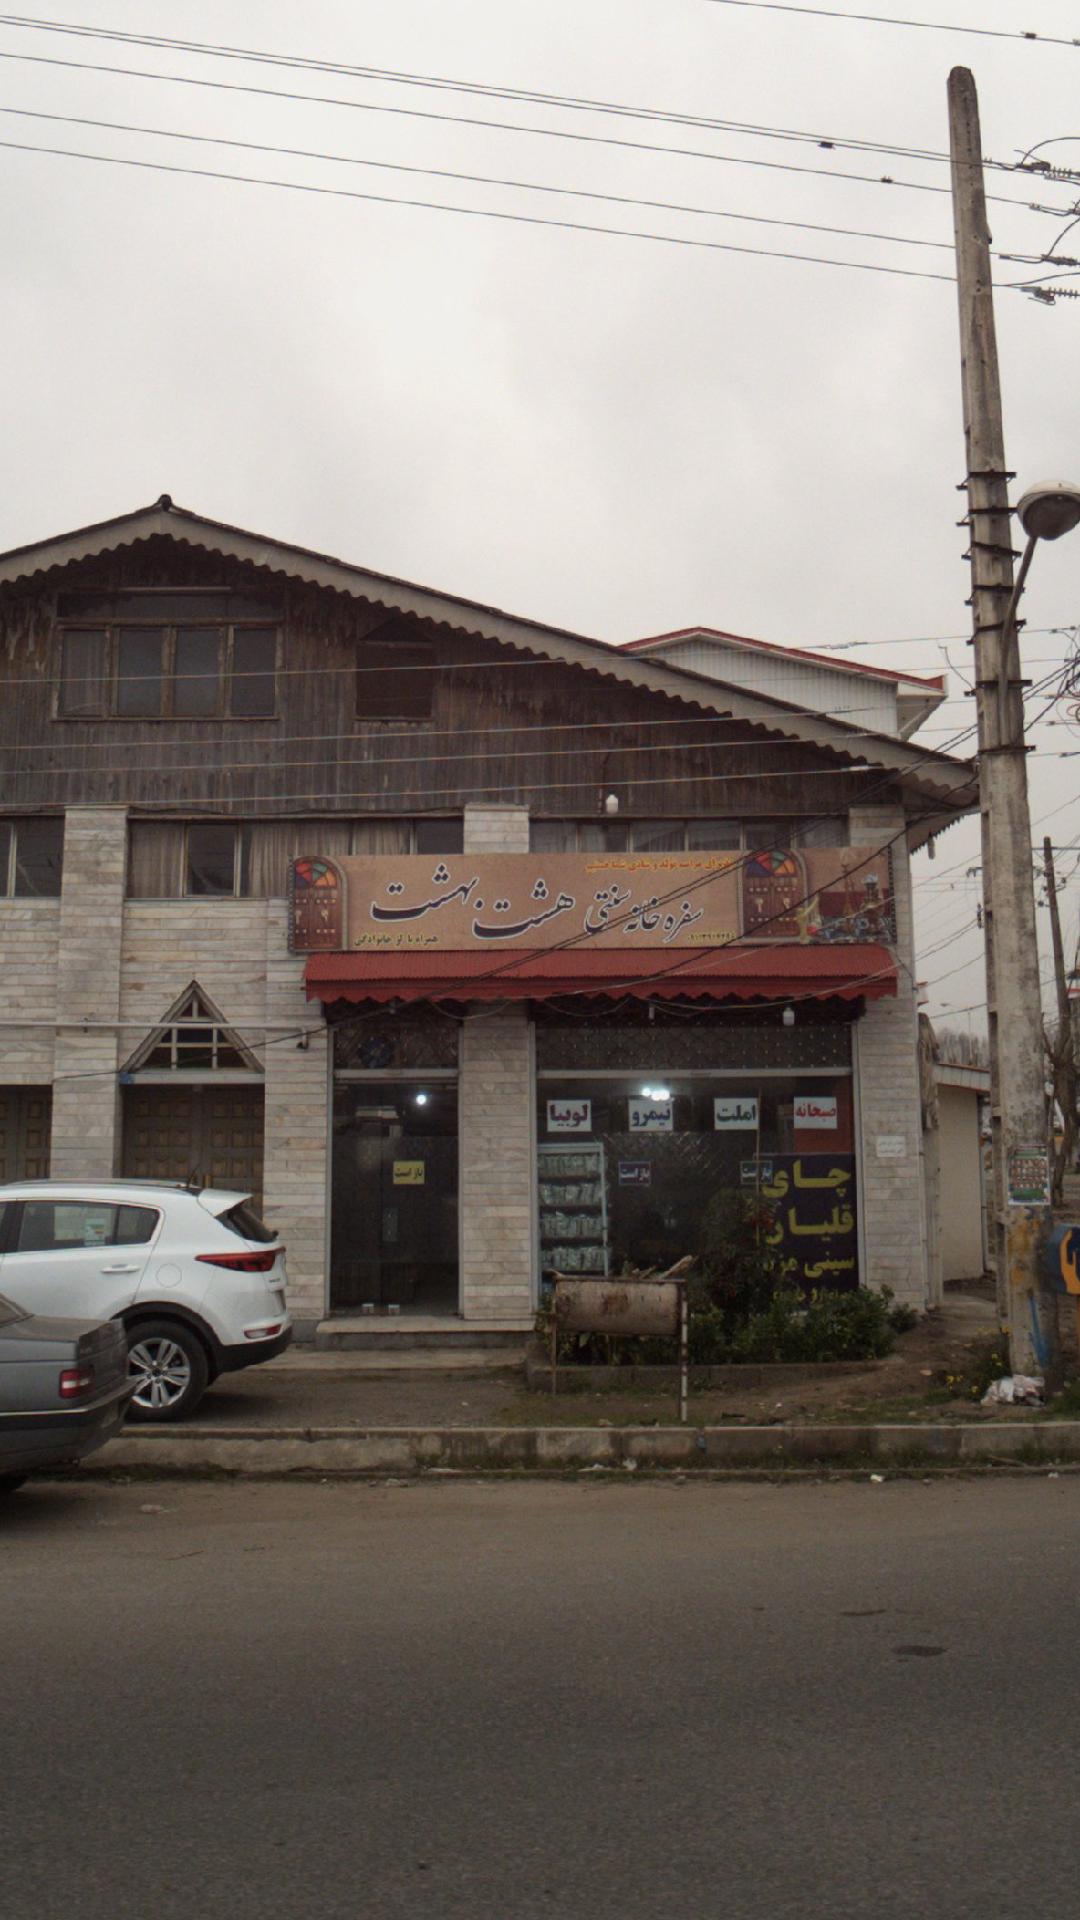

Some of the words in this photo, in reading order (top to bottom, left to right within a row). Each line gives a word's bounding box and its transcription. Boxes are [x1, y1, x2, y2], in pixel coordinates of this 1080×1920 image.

[371, 864, 484, 922] بهشت
[472, 878, 576, 939] هشت
[584, 884, 632, 935] سنتی
[622, 896, 662, 933] خانه
[662, 902, 704, 943] سفره
[353, 934, 392, 948] خانوادگی
[407, 934, 414, 944] با
[415, 934, 439, 948] همراه
[549, 1103, 589, 1127] لوبیا
[631, 1102, 671, 1127] نیمرو
[716, 1104, 756, 1121] املت
[795, 1103, 837, 1123] صبحانه
[394, 1167, 411, 1178] است
[761, 1159, 851, 1198] چای
[804, 1250, 855, 1278] سینی
